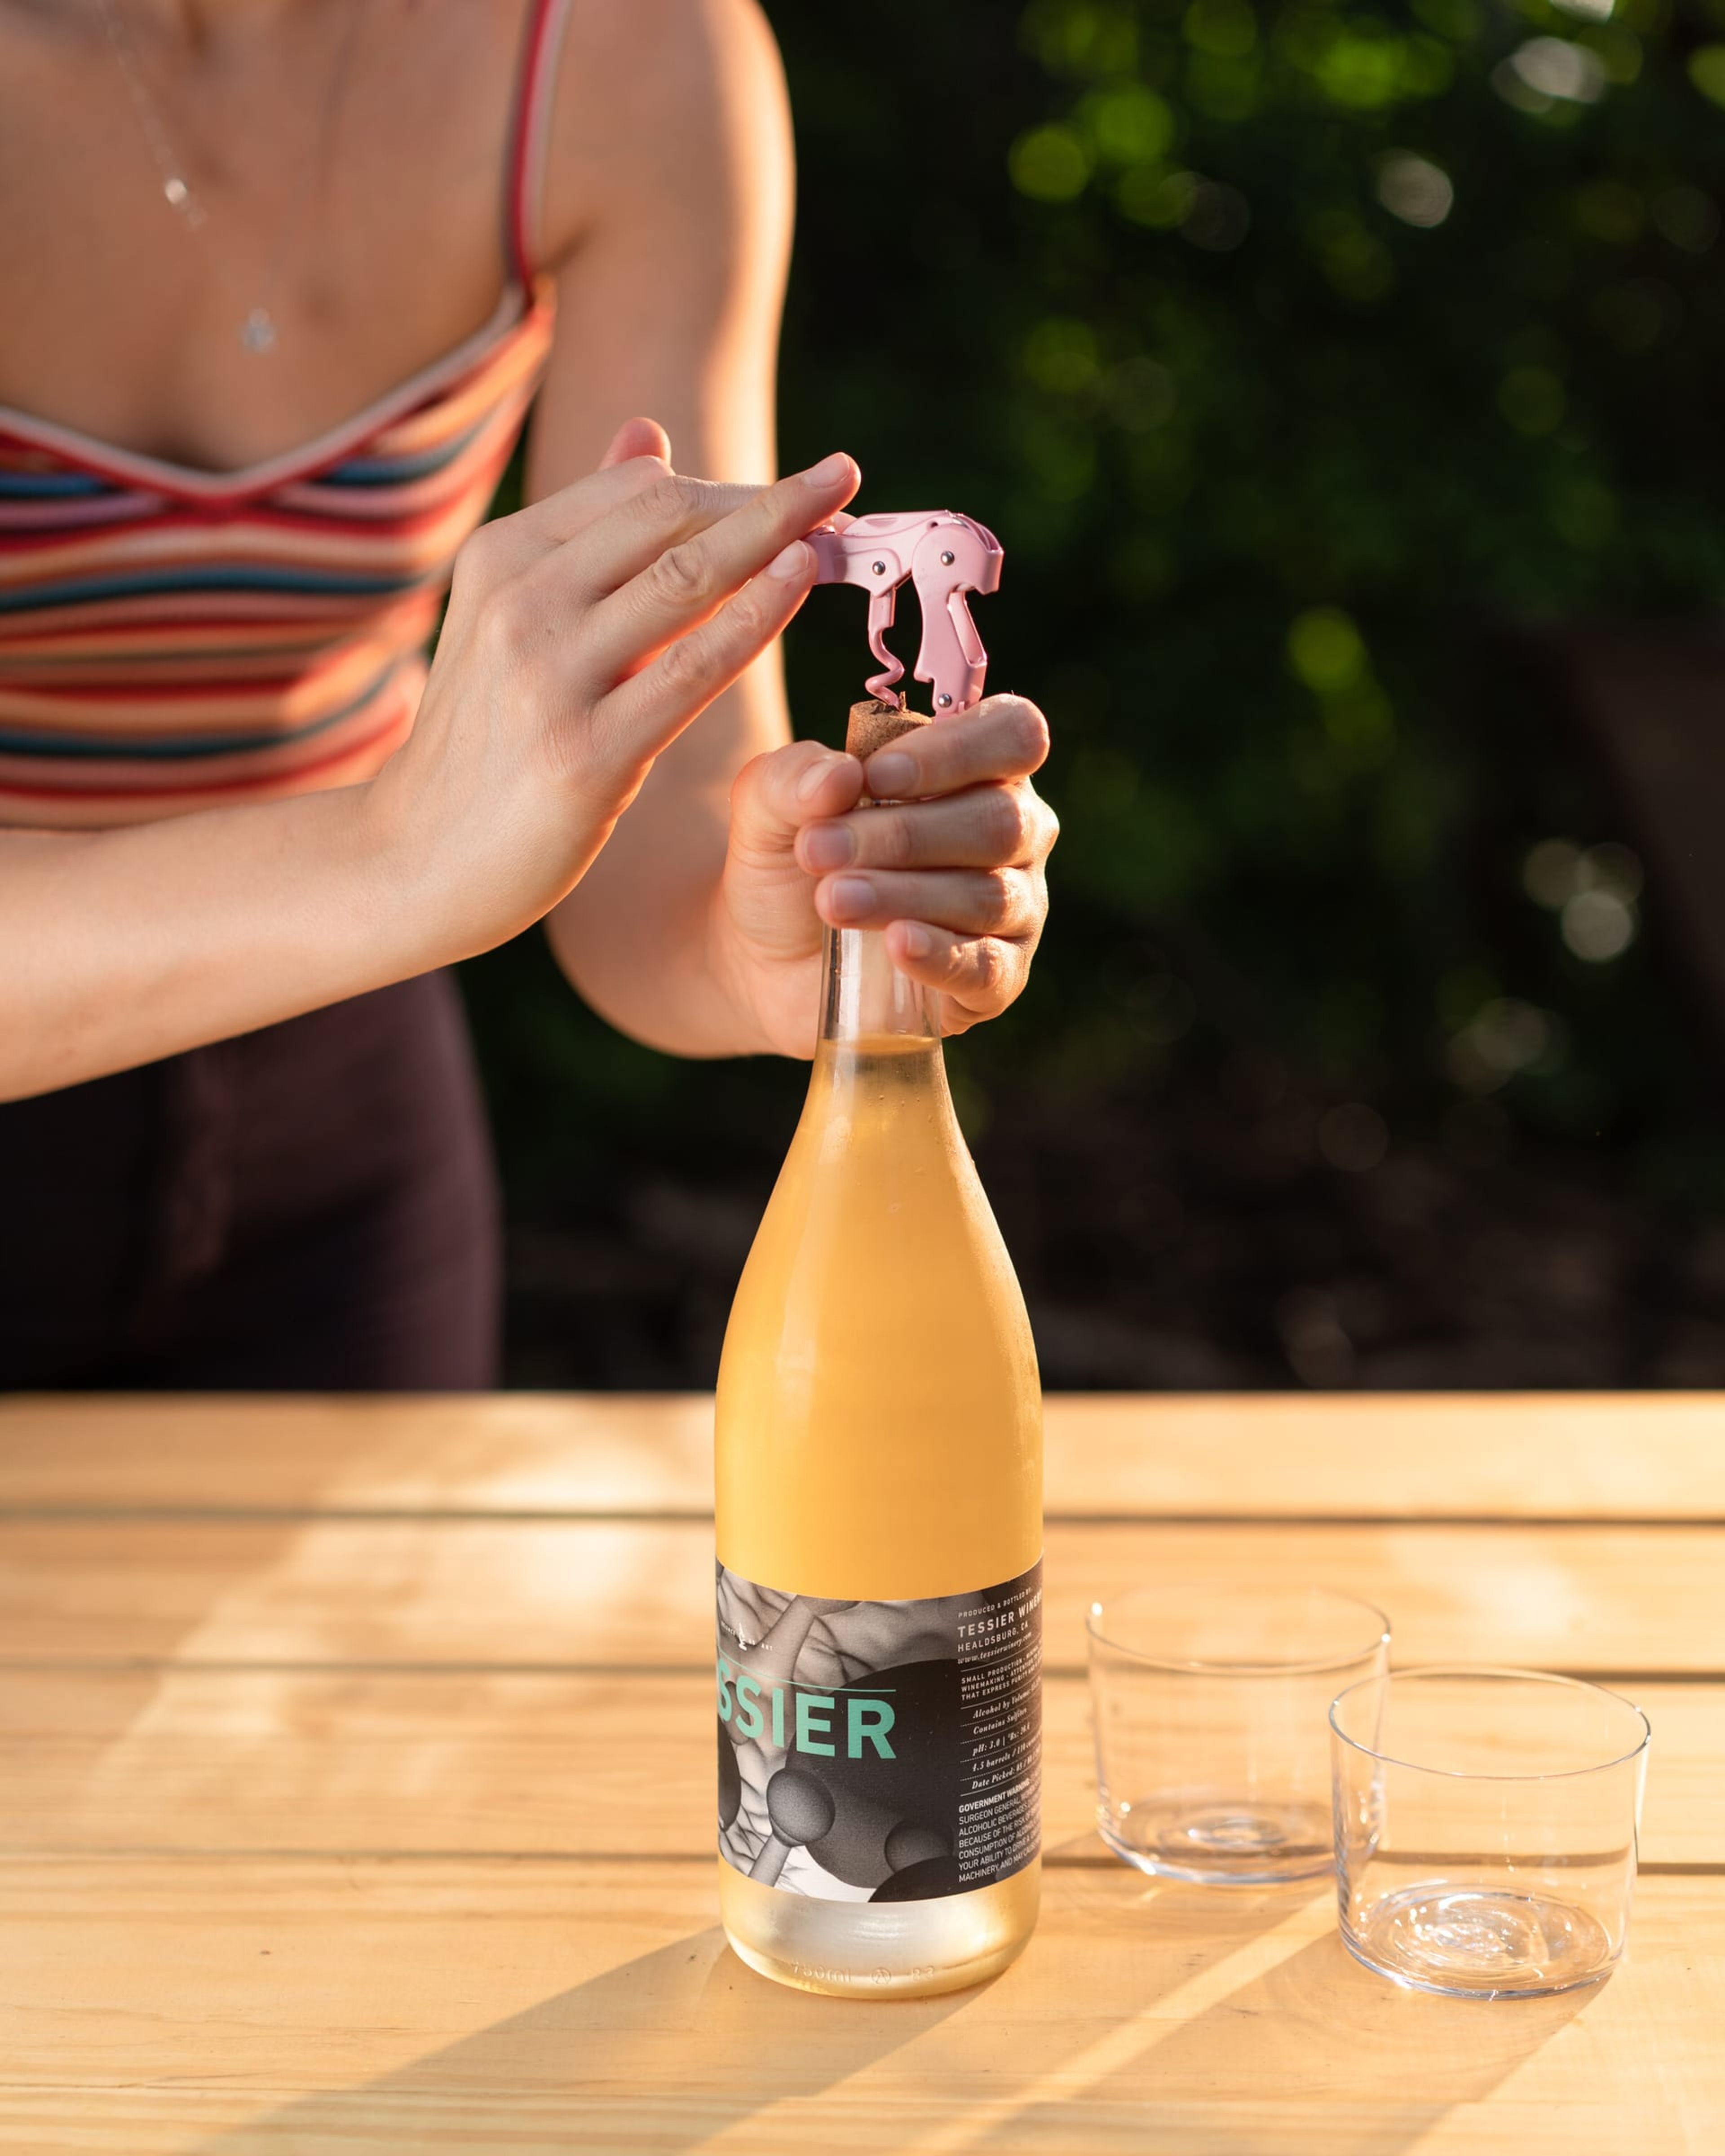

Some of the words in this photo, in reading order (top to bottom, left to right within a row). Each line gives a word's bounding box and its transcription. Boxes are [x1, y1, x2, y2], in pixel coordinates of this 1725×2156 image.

[958, 1604, 995, 1618] PRODUCED
[1003, 1592, 1025, 1607] BOTTLED
[957, 1611, 1014, 1638] TESSIER
[1021, 1620, 1028, 1631] CA
[957, 1631, 1032, 1665] www.tessierwinery.com
[961, 1673, 985, 1684] SMALL
[987, 1658, 1022, 1677] PRODUCTION
[961, 1674, 1004, 1692] WINEMAKING
[961, 1691, 980, 1701] THAT
[982, 1680, 1010, 1696] EXPRESS
[973, 1703, 1001, 1719] Alcohol
[1002, 1701, 1010, 1710] by
[973, 1720, 1005, 1735] Contains
[972, 1743, 987, 1757] pH:
[989, 1738, 1000, 1750] 3.0
[972, 1761, 985, 1772] 4.5
[986, 1753, 1011, 1768] barrels
[972, 1779, 990, 1789] Date
[991, 1767, 1015, 1783] Picked:
[959, 1791, 1006, 1813] GOVERNMENT
[959, 1807, 993, 1825] SURGEON
[959, 1818, 997, 1837] ALCOHOLIC
[959, 1832, 991, 1848] BECAUSE
[993, 1829, 1001, 1838] OF
[1003, 1822, 1013, 1834] THE
[959, 1835, 1007, 1860] CONSUMPTION
[1008, 1833, 1016, 1842] OF
[959, 1859, 979, 1871] YOUR
[980, 1850, 1004, 1866] ABILITY
[959, 1865, 1000, 1882] MACHINERY,
[1000, 1858, 1013, 1869] AND
